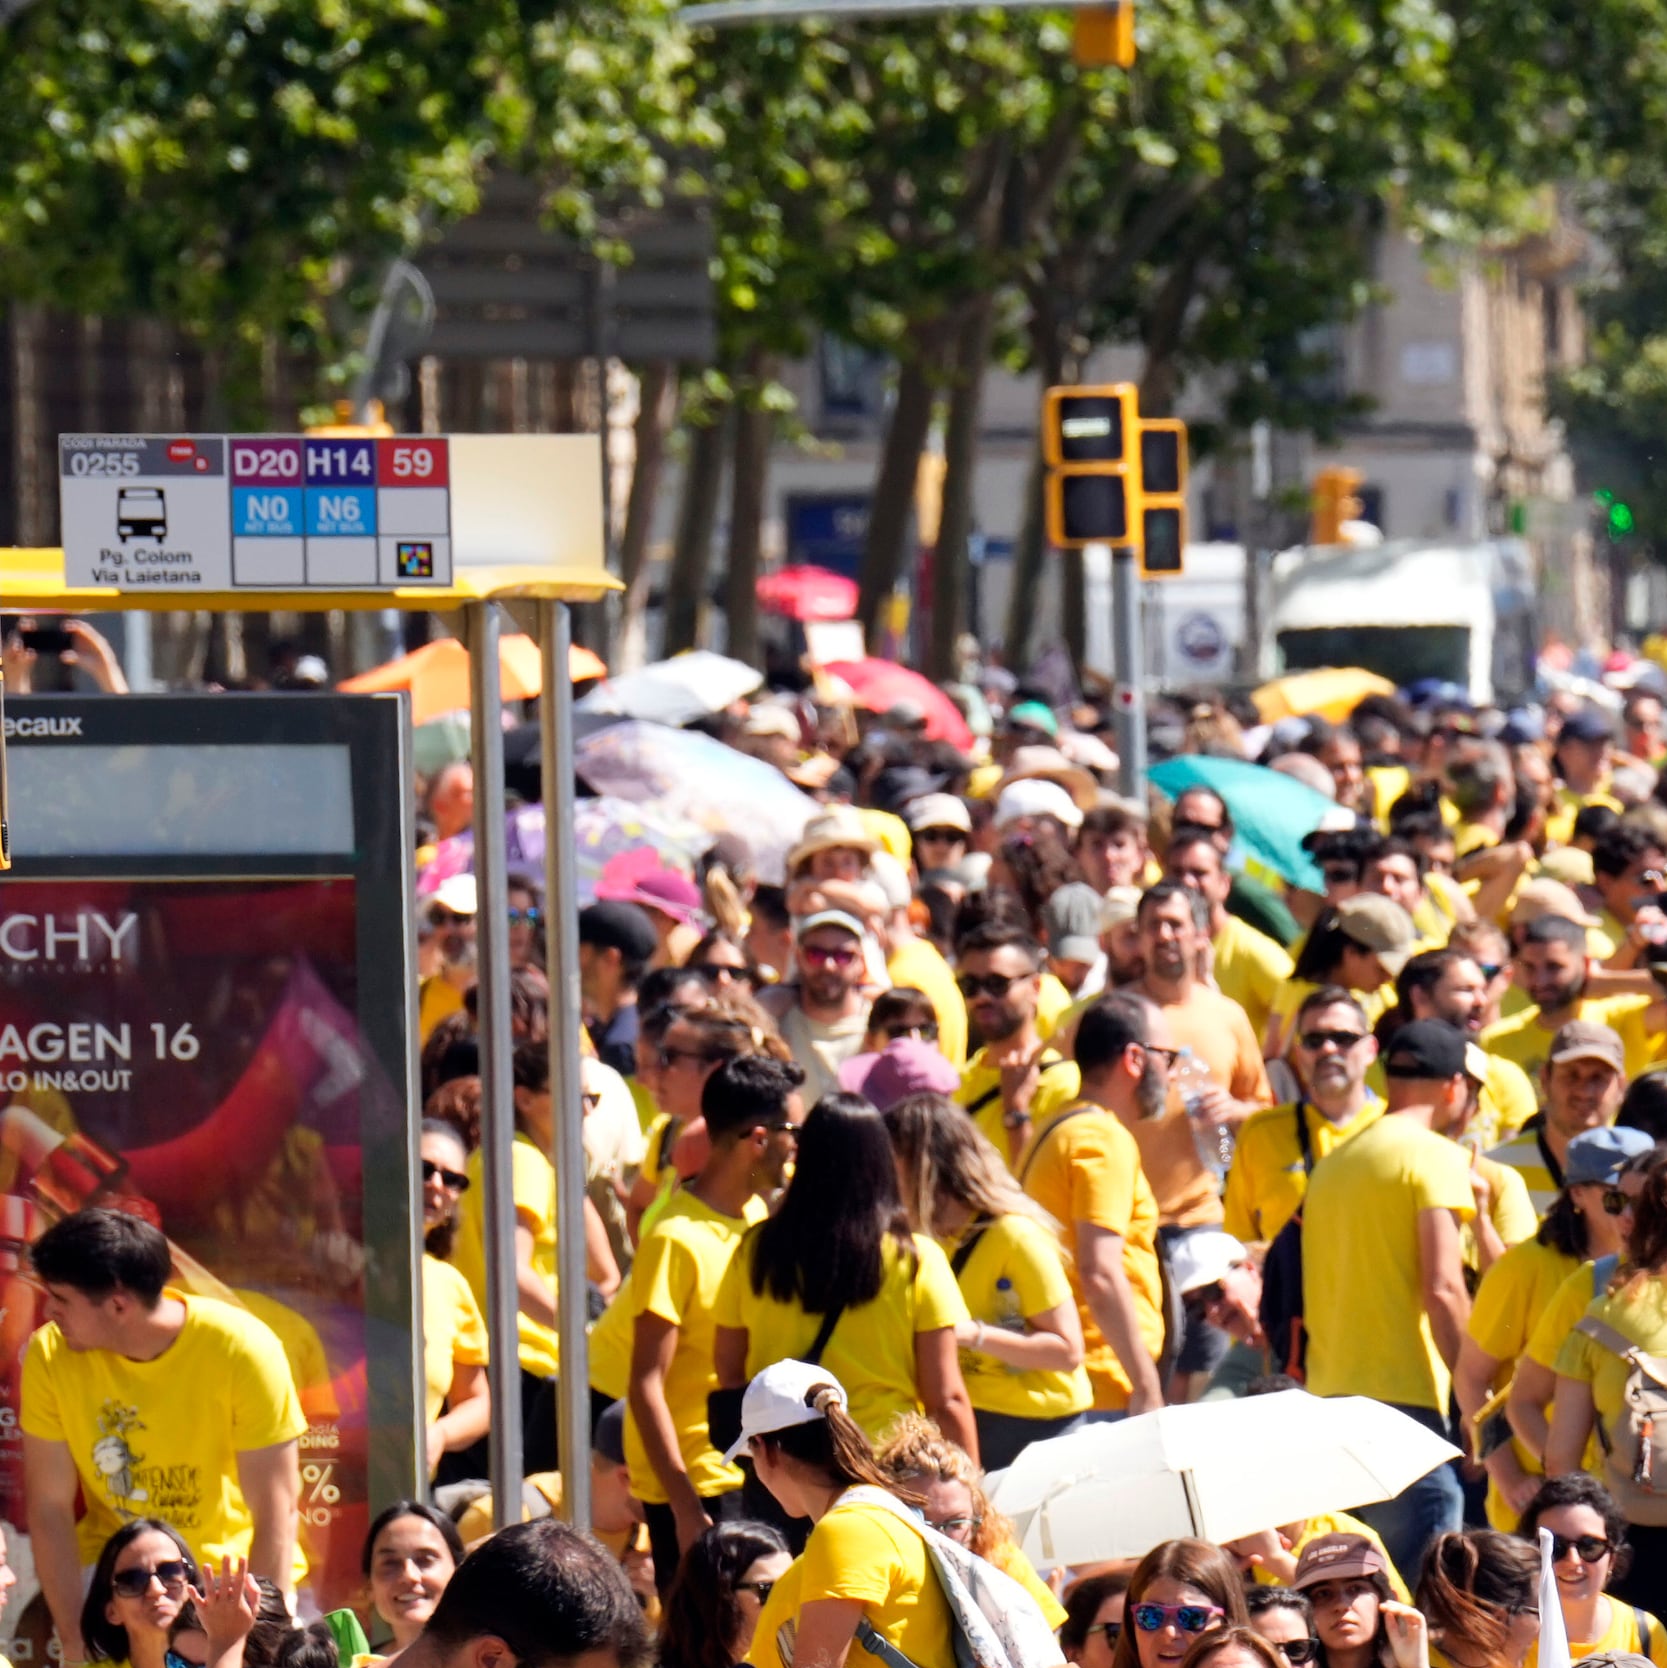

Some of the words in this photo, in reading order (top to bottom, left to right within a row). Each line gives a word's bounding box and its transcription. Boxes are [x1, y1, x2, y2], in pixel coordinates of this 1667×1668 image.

[70, 452, 141, 476] 0255
[234, 448, 299, 477] D20
[307, 447, 371, 477] H14
[392, 448, 434, 476] 59
[246, 494, 290, 521] N0
[318, 495, 362, 521] N6
[101, 549, 128, 566] Pg.
[134, 549, 193, 565] Colom
[92, 568, 119, 583] Via
[125, 568, 202, 584] Laietana
[0, 912, 138, 961] CHY
[0, 1022, 132, 1063] AGEN
[150, 1022, 200, 1061] 16
[34, 1070, 133, 1092] IN&OUT
